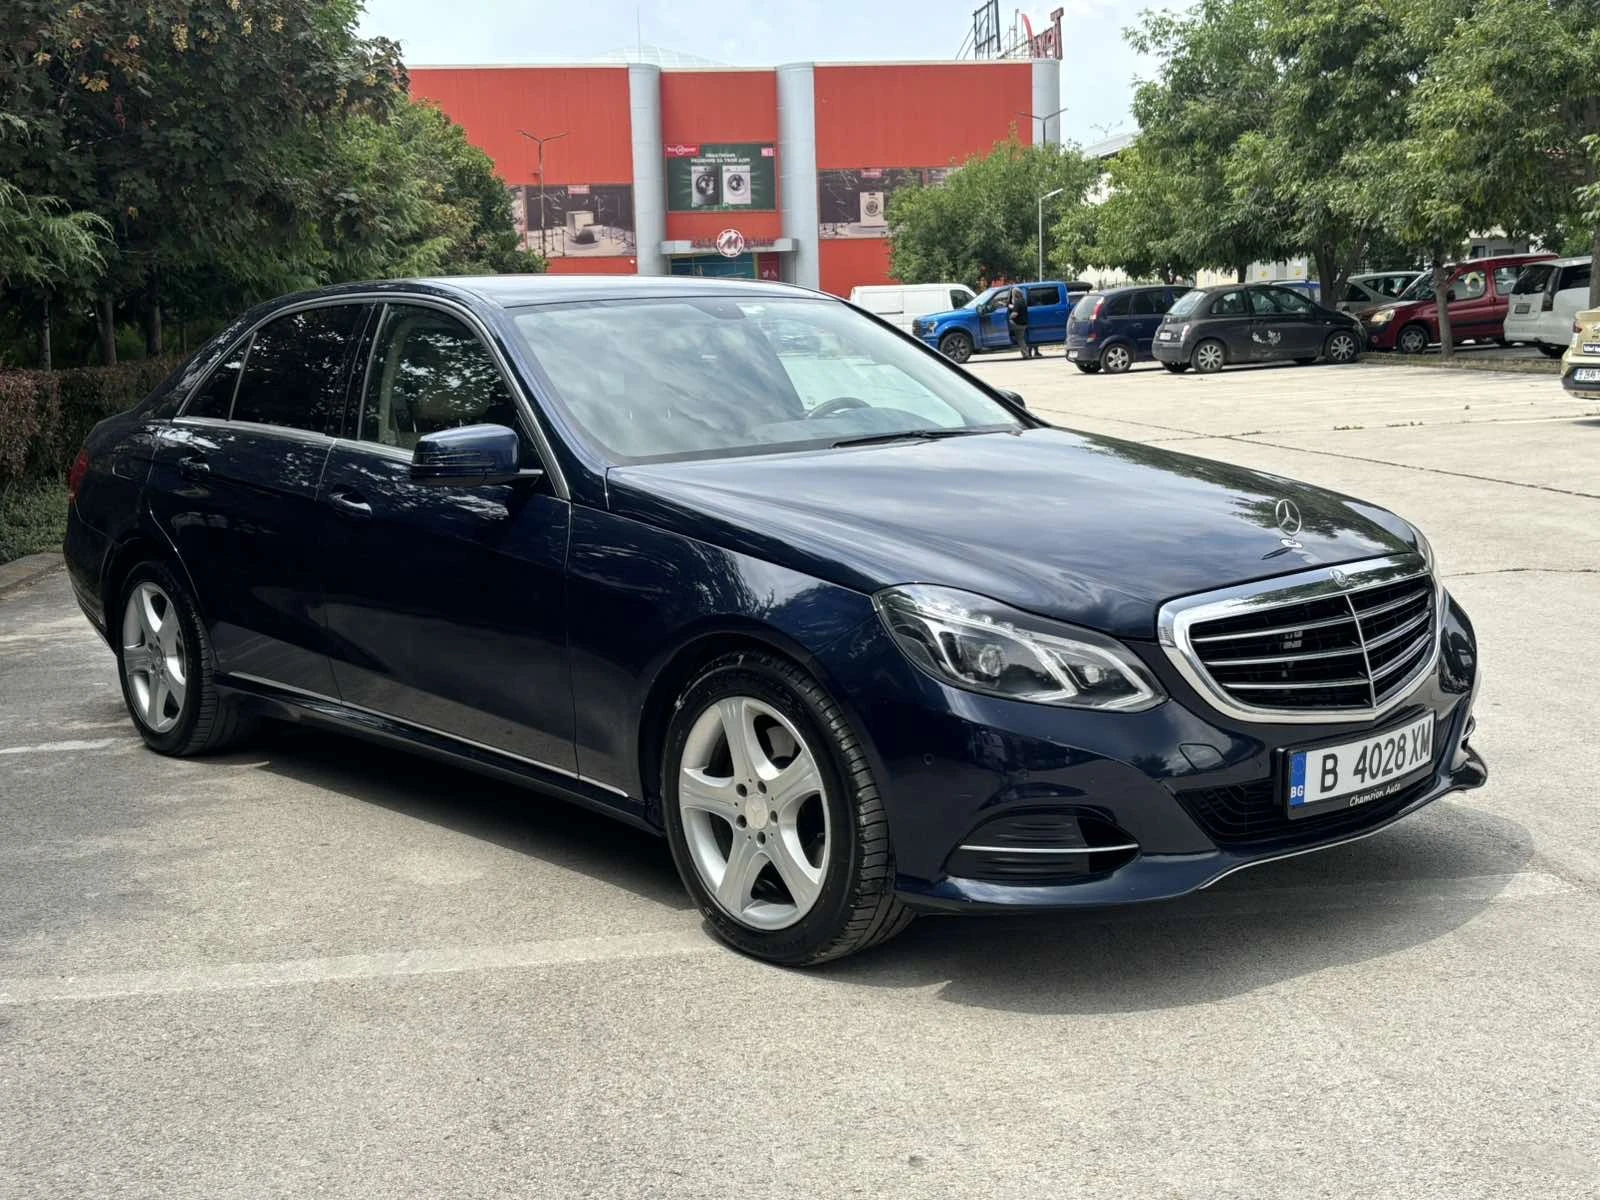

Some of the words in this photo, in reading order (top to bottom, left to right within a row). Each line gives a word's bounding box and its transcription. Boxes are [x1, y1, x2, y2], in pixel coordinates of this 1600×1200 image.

[1320, 753, 1339, 793] B
[1353, 733, 1407, 783] 4028
[1409, 720, 1431, 764] XM
[1290, 785, 1305, 798] BG
[1349, 789, 1385, 807] Champion
[1386, 783, 1401, 795] Auto
